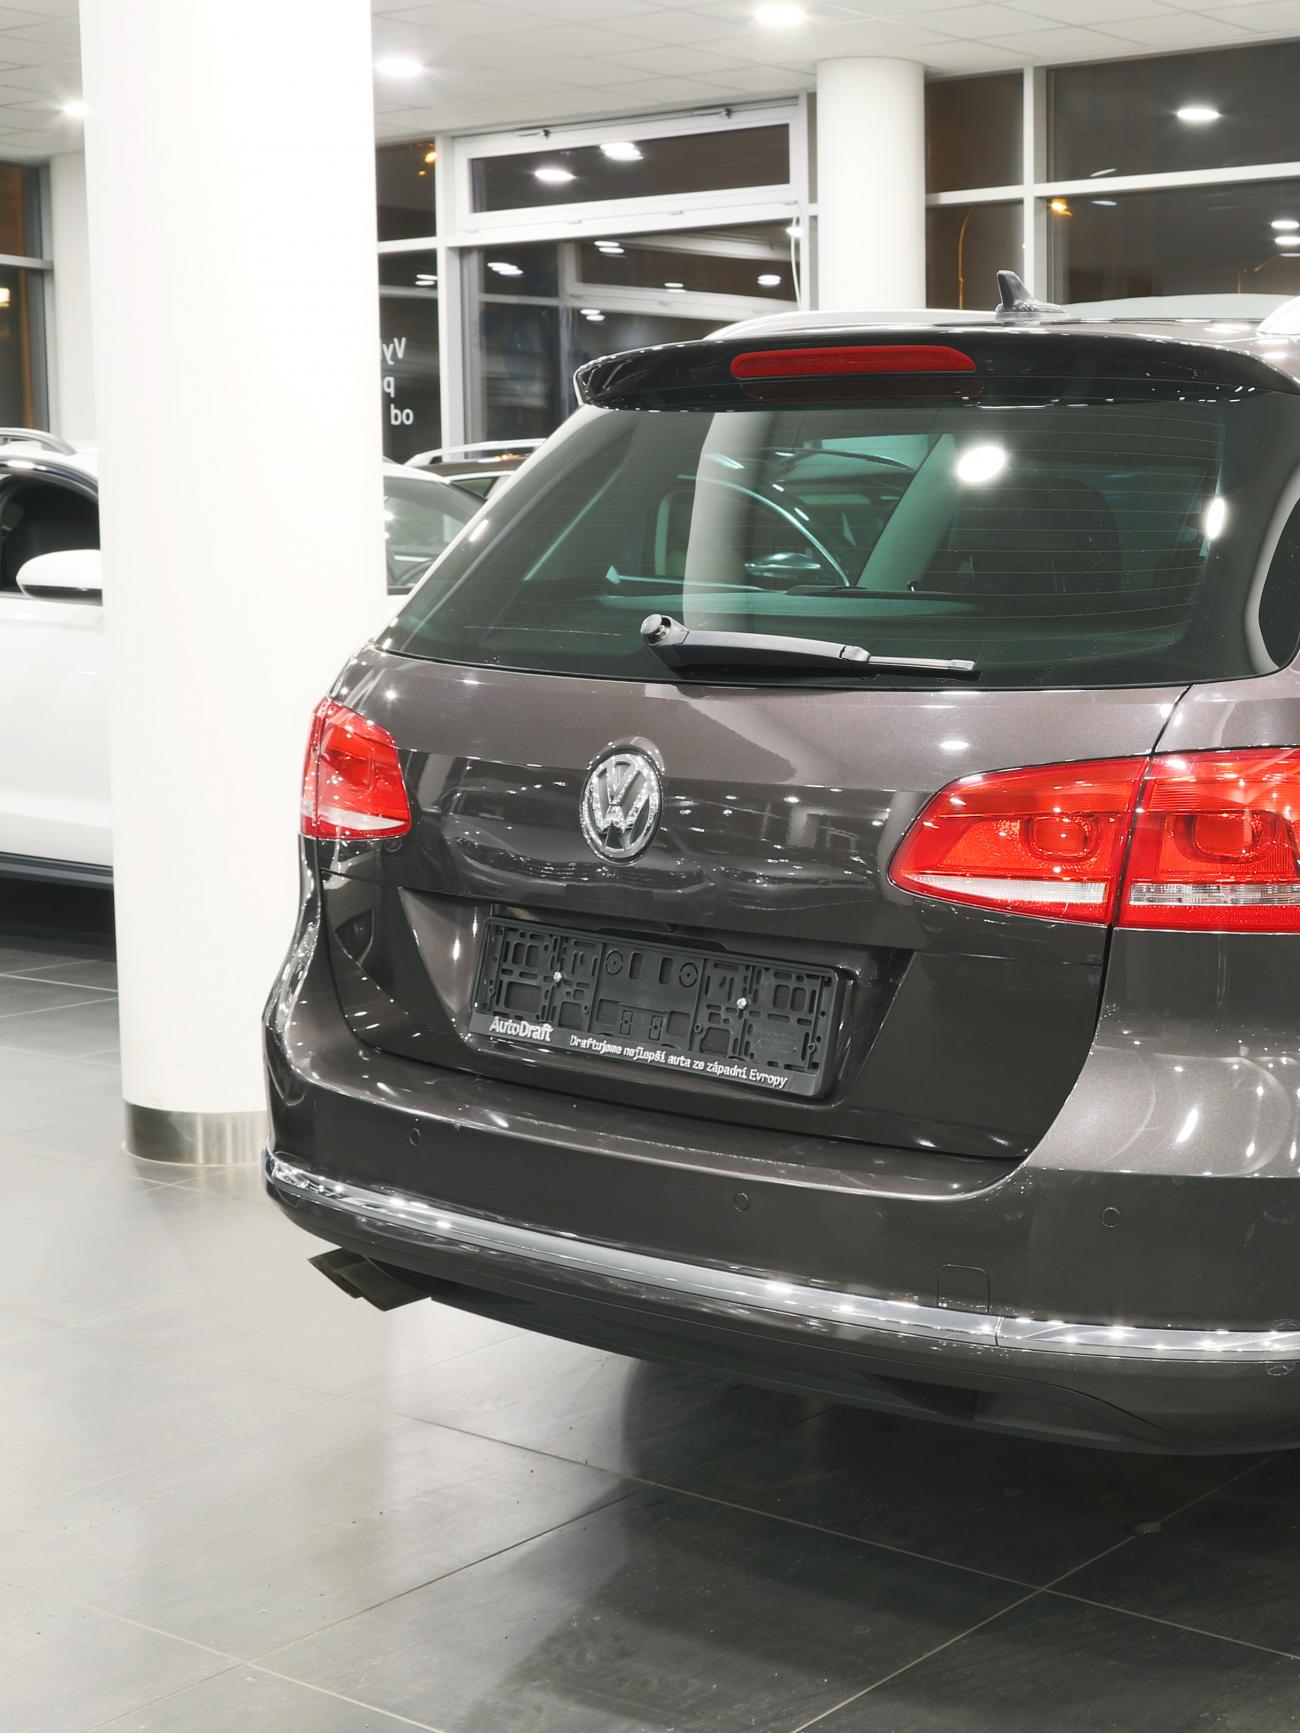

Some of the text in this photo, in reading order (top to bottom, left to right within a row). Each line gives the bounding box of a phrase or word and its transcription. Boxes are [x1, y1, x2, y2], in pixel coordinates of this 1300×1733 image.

[489, 1016, 553, 1042] AutoDraft
[570, 1034, 622, 1054] Draftujeme
[667, 1054, 691, 1068] auta
[692, 1060, 705, 1070] ze
[706, 1061, 748, 1079] západní
[749, 1068, 788, 1089] Evropy
